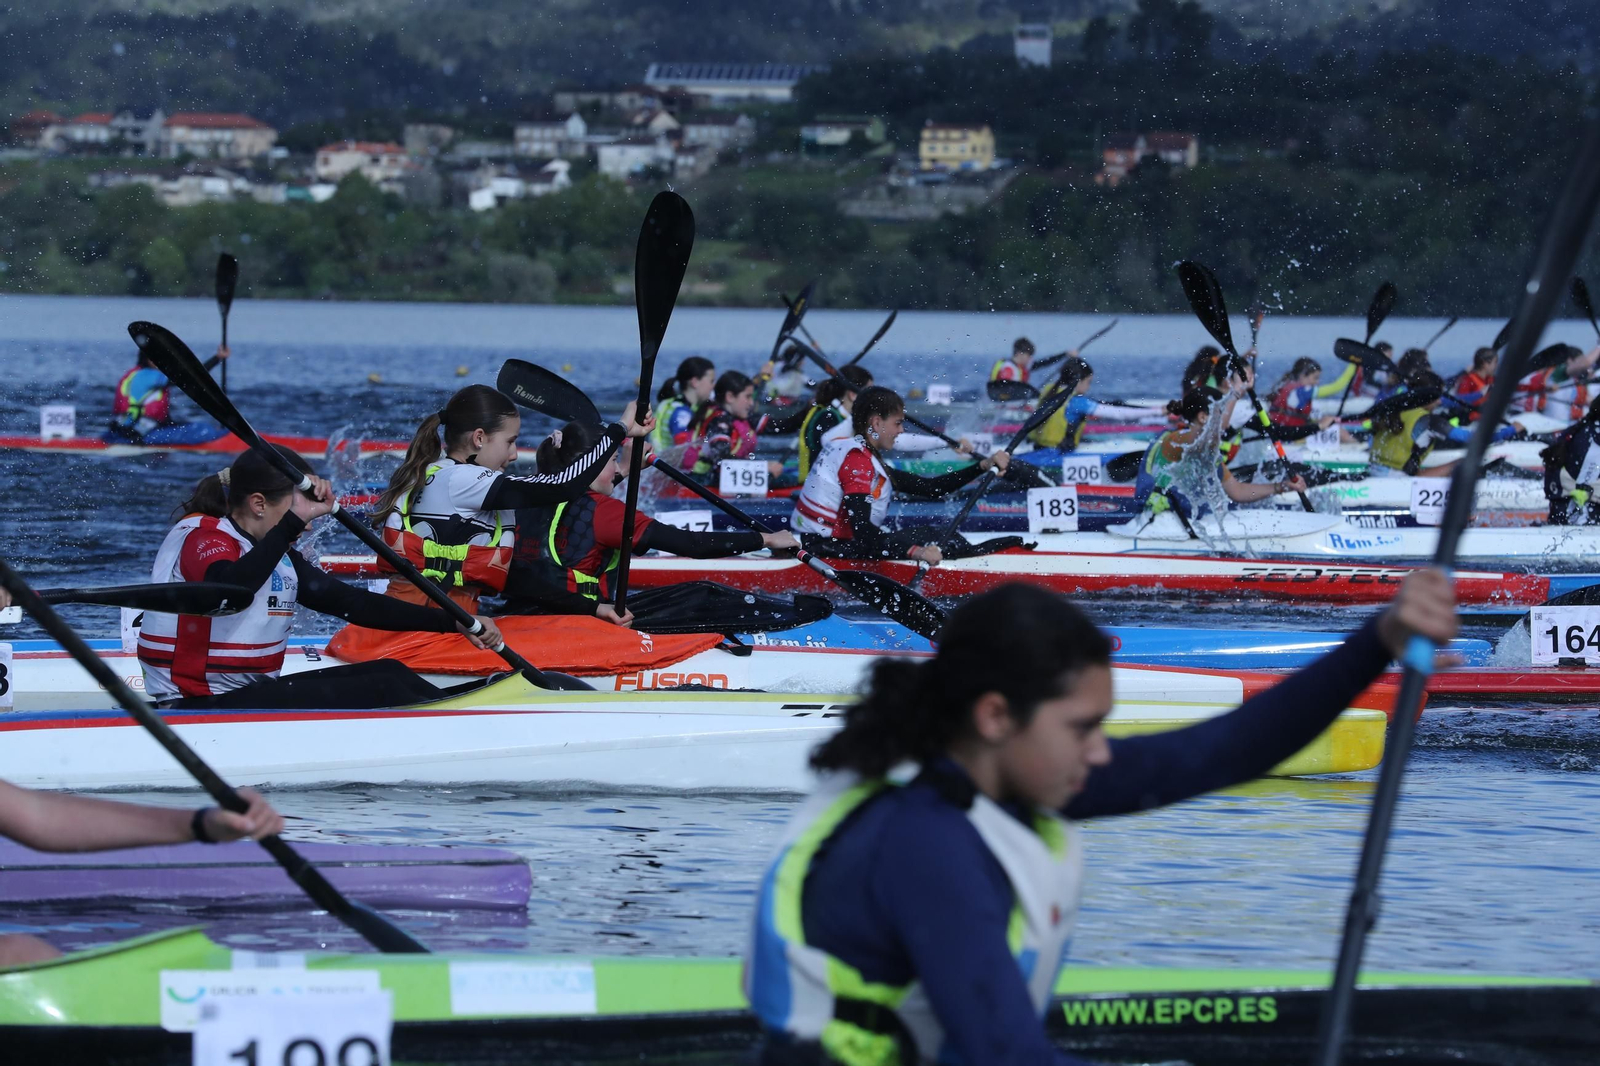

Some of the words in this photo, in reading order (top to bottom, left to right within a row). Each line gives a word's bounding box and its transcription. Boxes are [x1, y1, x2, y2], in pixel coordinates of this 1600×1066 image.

[730, 470, 765, 487] 195
[1067, 465, 1099, 481] 206
[1035, 498, 1076, 518] 183
[1234, 568, 1415, 584] ZEDTEC
[1545, 625, 1600, 654] 164
[614, 673, 729, 692] FUSION
[1062, 996, 1279, 1026] WWW.EPCP.ES
